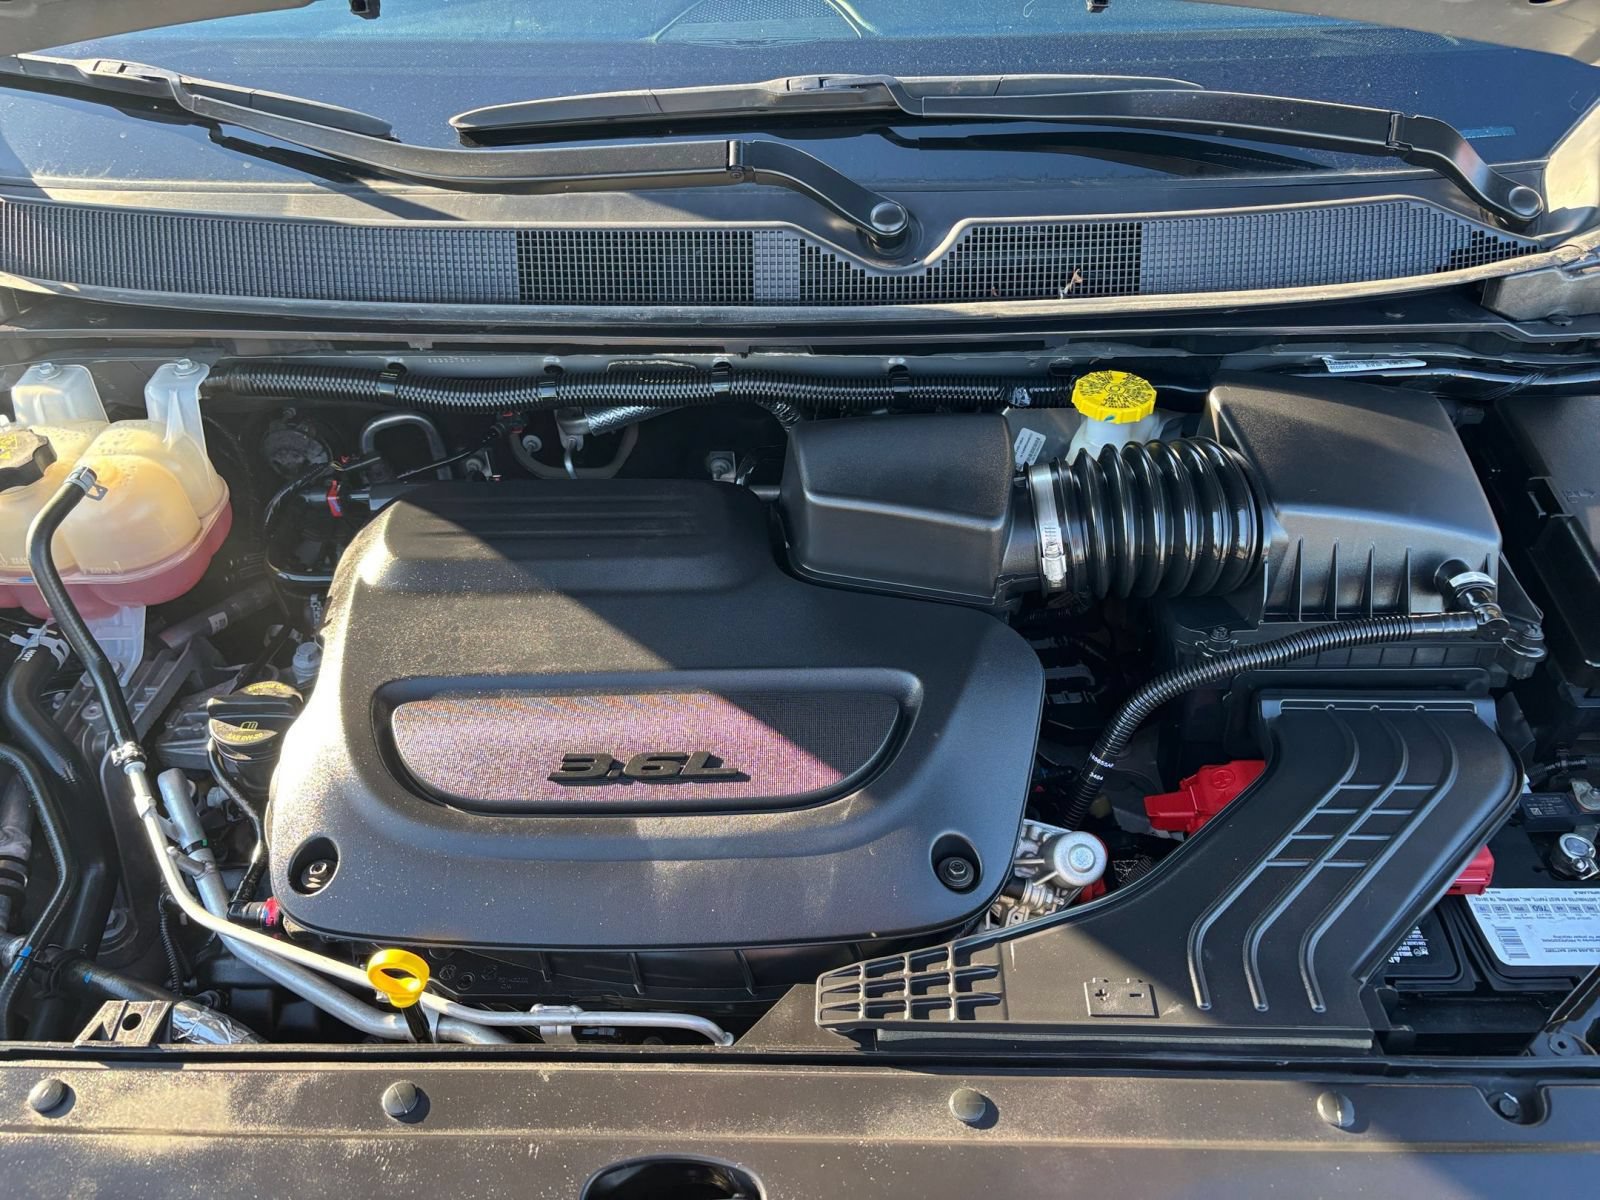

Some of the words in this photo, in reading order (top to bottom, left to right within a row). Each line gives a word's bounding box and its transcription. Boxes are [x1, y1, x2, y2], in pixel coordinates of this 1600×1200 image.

[21, 649, 37, 662] HOT
[247, 683, 275, 692] ENGINE
[547, 751, 738, 780] 3.6L
